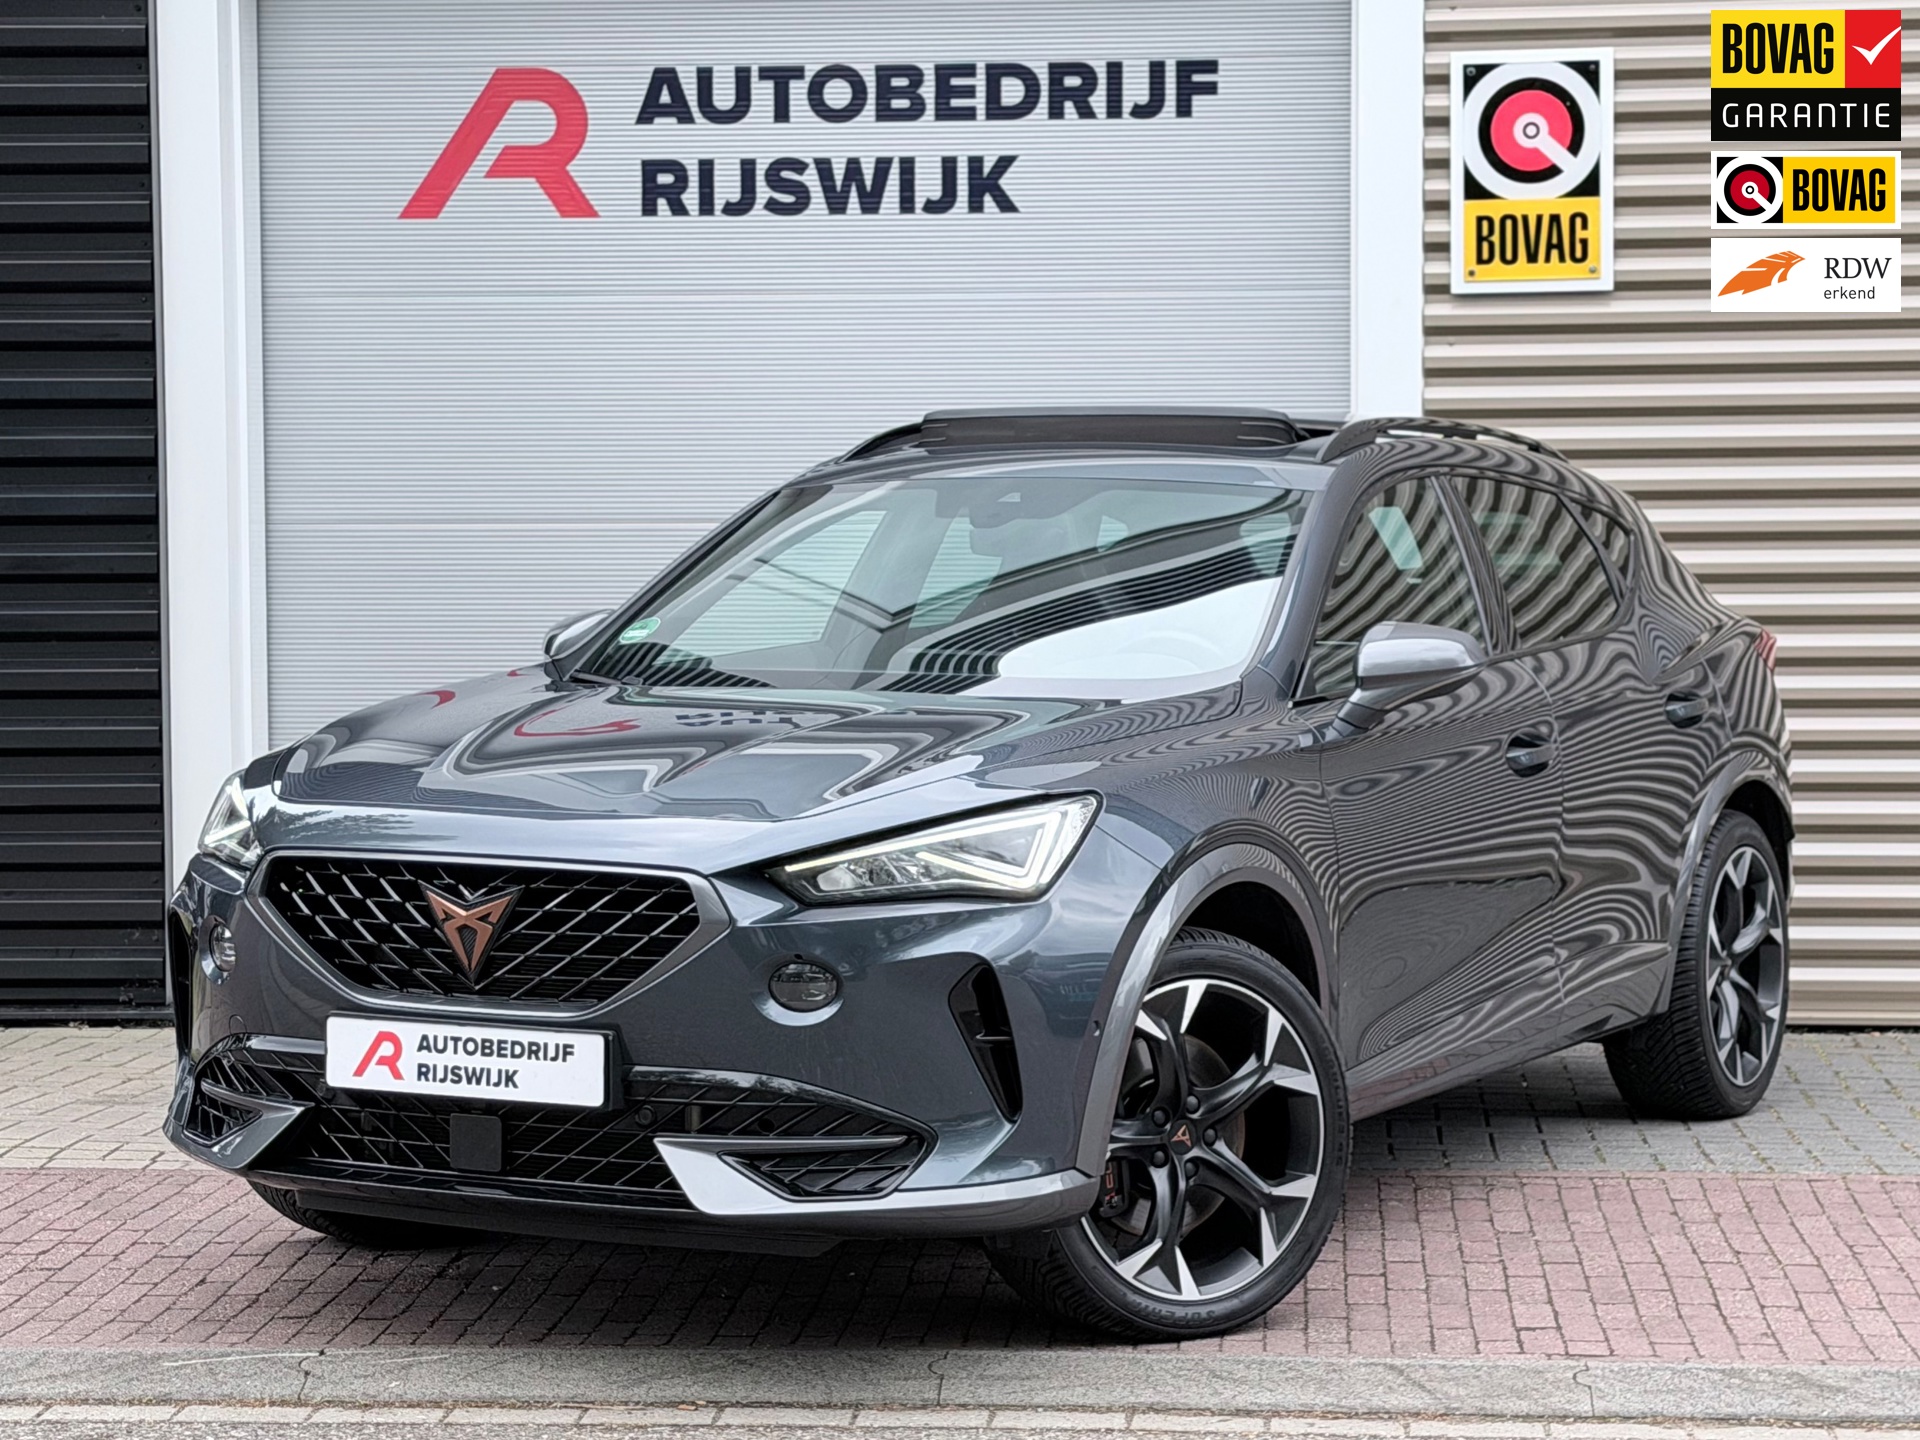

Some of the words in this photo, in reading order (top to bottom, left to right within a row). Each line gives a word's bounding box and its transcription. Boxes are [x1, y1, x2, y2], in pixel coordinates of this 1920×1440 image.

[635, 60, 1218, 125] AUTOBEDRIJF
[640, 155, 1020, 217] RIJSWIJK
[1476, 212, 1589, 265] BOVAG
[416, 1034, 575, 1063] AUTOBEDRIJF
[416, 1063, 520, 1089] RIJSWIJK
